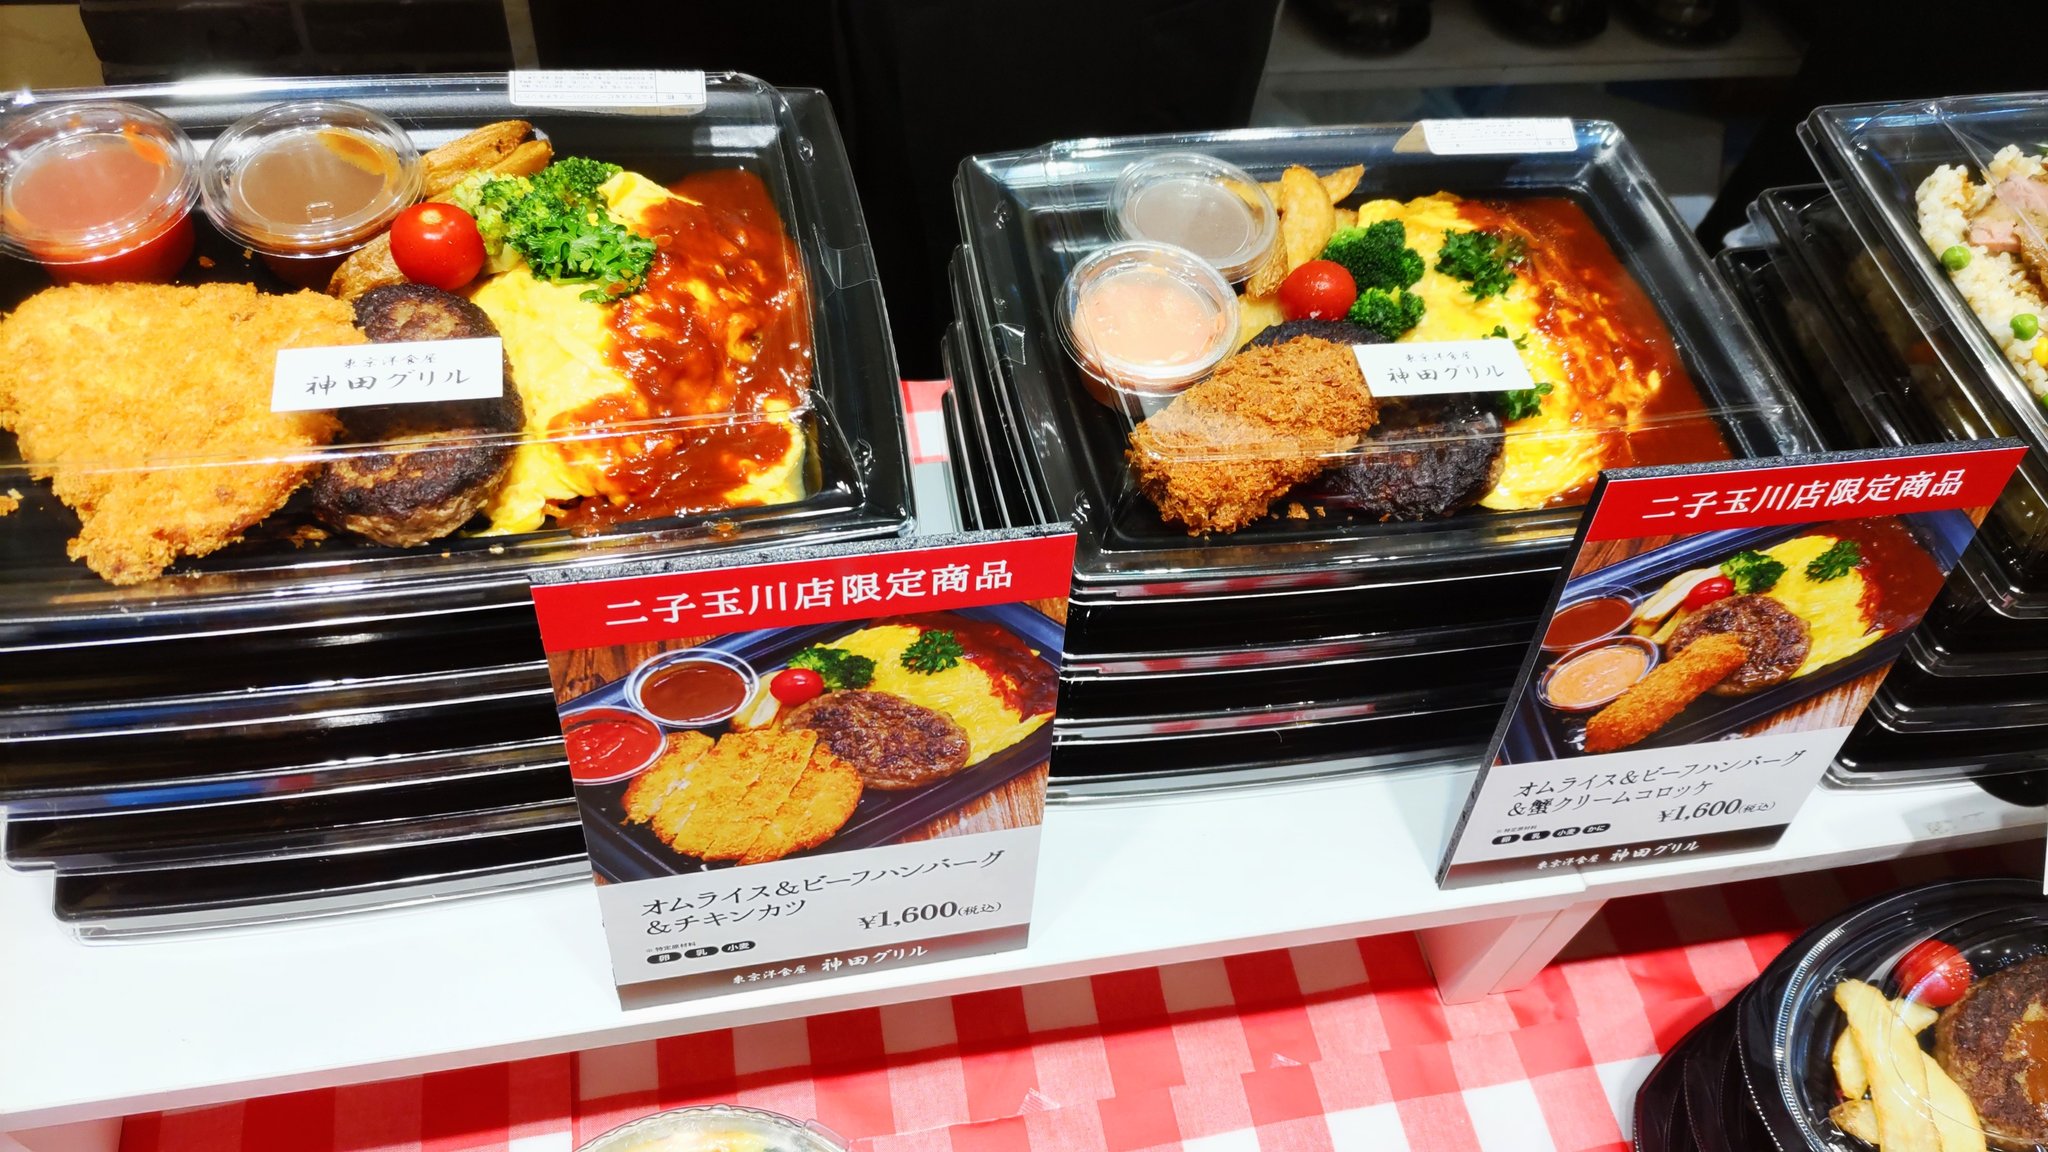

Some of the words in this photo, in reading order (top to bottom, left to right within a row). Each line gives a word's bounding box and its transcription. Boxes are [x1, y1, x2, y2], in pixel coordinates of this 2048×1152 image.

[305, 368, 471, 396] 神田グリル
[1387, 364, 1505, 384] 神田グリル
[1642, 468, 1966, 520] 二子玉川店限定商品
[605, 559, 1014, 626] 二子玉川店限定商品
[1609, 841, 1701, 863] 神田グリル
[647, 899, 808, 936] &チキンカツ
[733, 964, 807, 985] 東京洋食屋
[821, 945, 928, 972] 神田グリル
